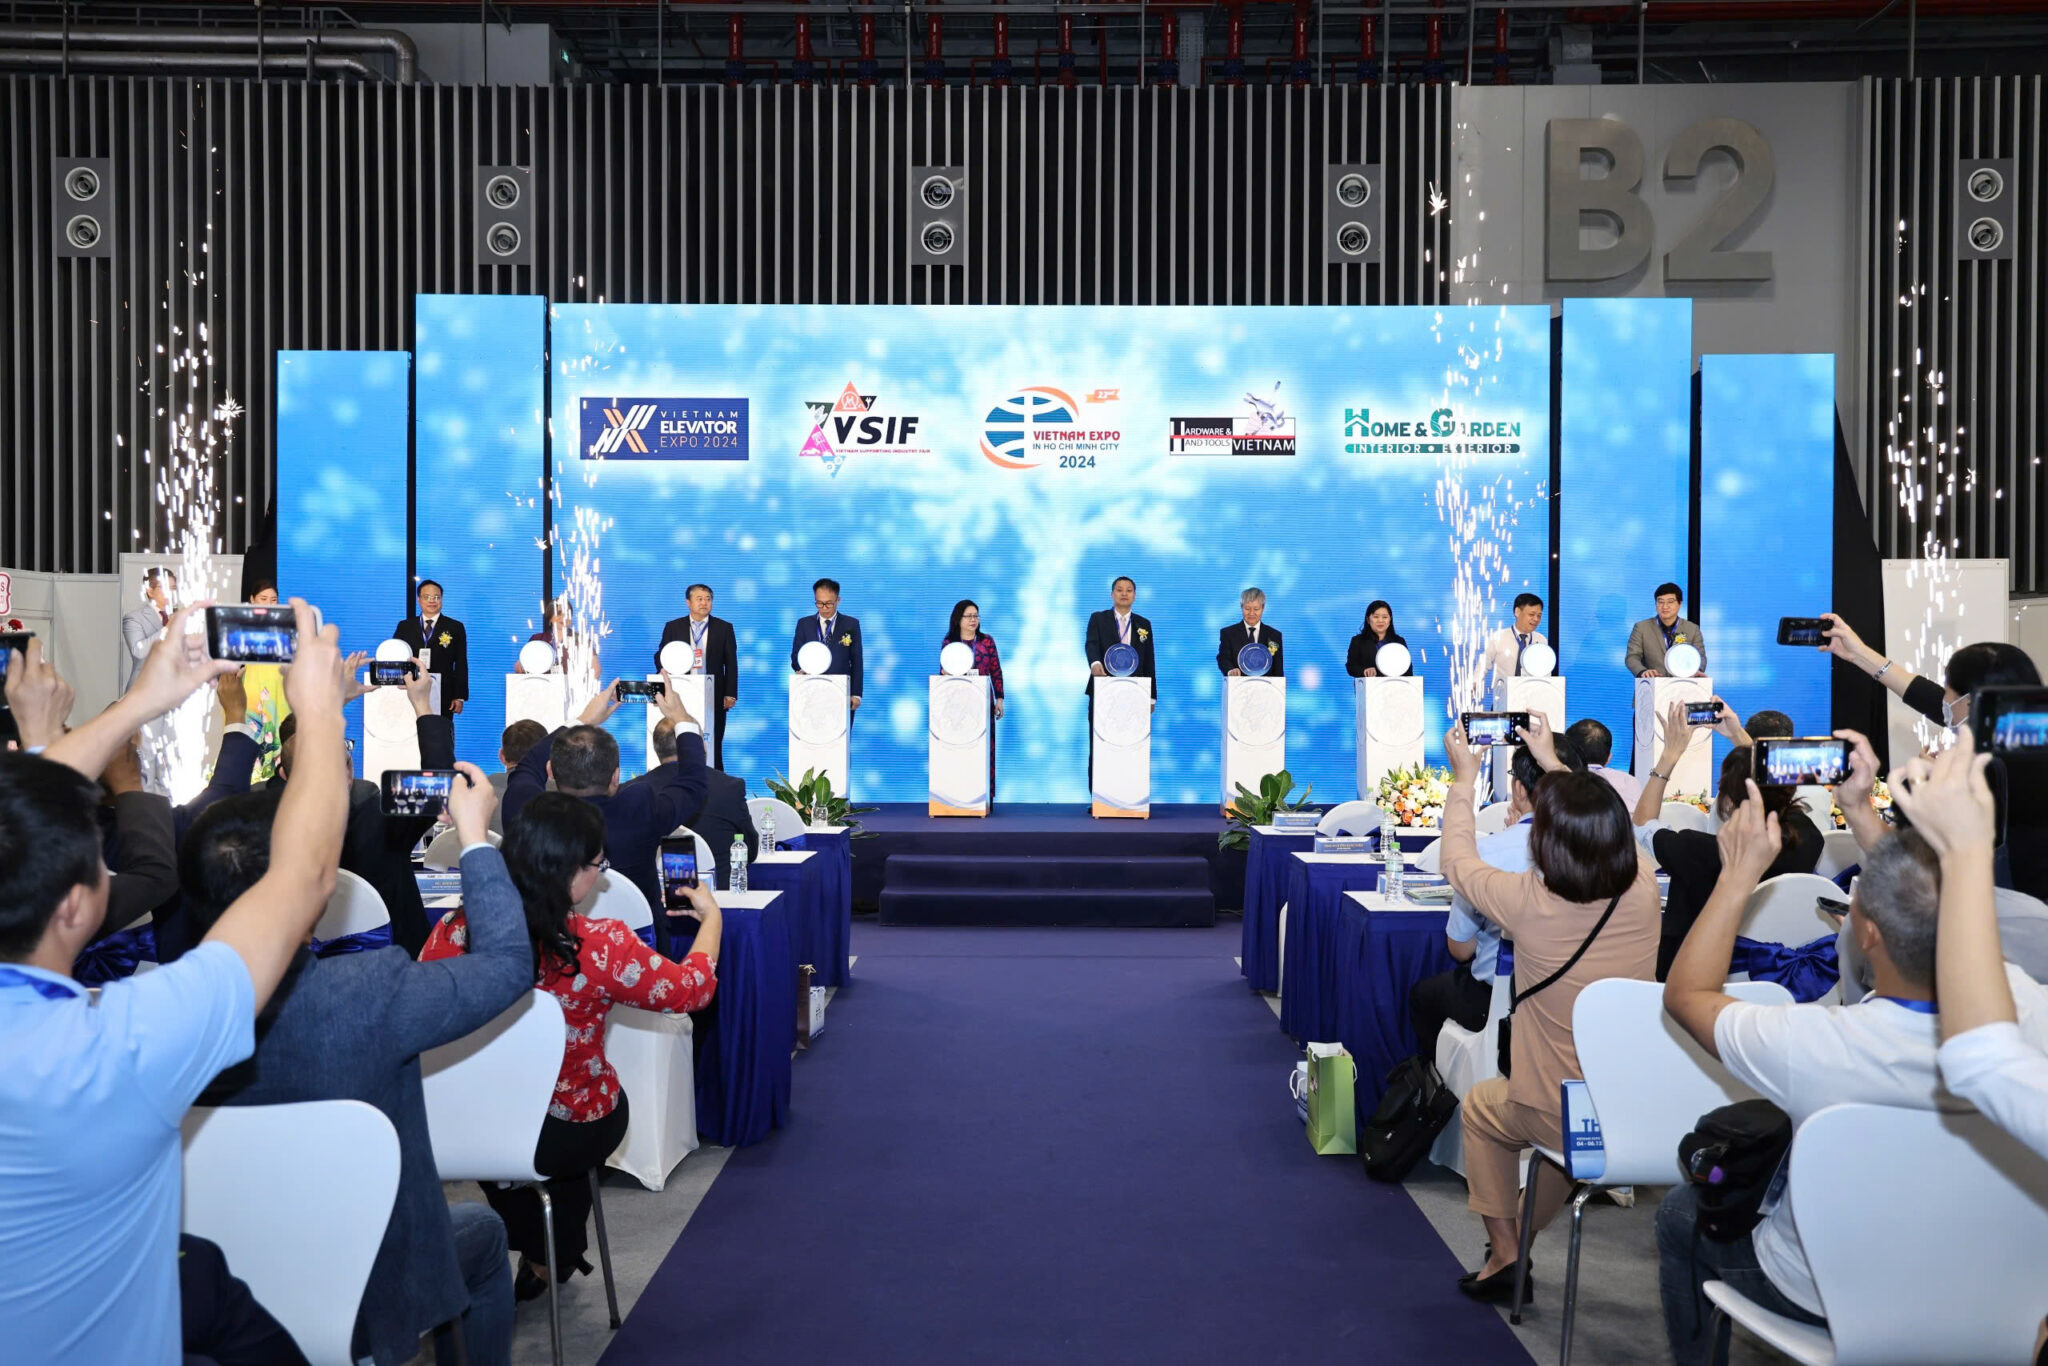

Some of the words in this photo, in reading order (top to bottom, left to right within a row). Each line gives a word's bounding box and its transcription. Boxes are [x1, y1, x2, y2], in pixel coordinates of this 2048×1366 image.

[1544, 117, 1773, 282] B2
[660, 410, 738, 418] VIETNAM
[660, 421, 737, 434] ELEVATOR
[1345, 408, 1411, 437] HOME
[1414, 422, 1427, 437] &
[834, 416, 918, 444] VSIF
[1033, 430, 1085, 441] VIETNAM
[1089, 430, 1121, 441] EXPO
[660, 436, 698, 448] EXPO
[703, 436, 738, 448] 2024
[1204, 439, 1230, 447] TOOLS
[1233, 439, 1295, 450] VIETNAM
[1354, 444, 1421, 453] INTERIOR
[1059, 456, 1096, 469] 2024
